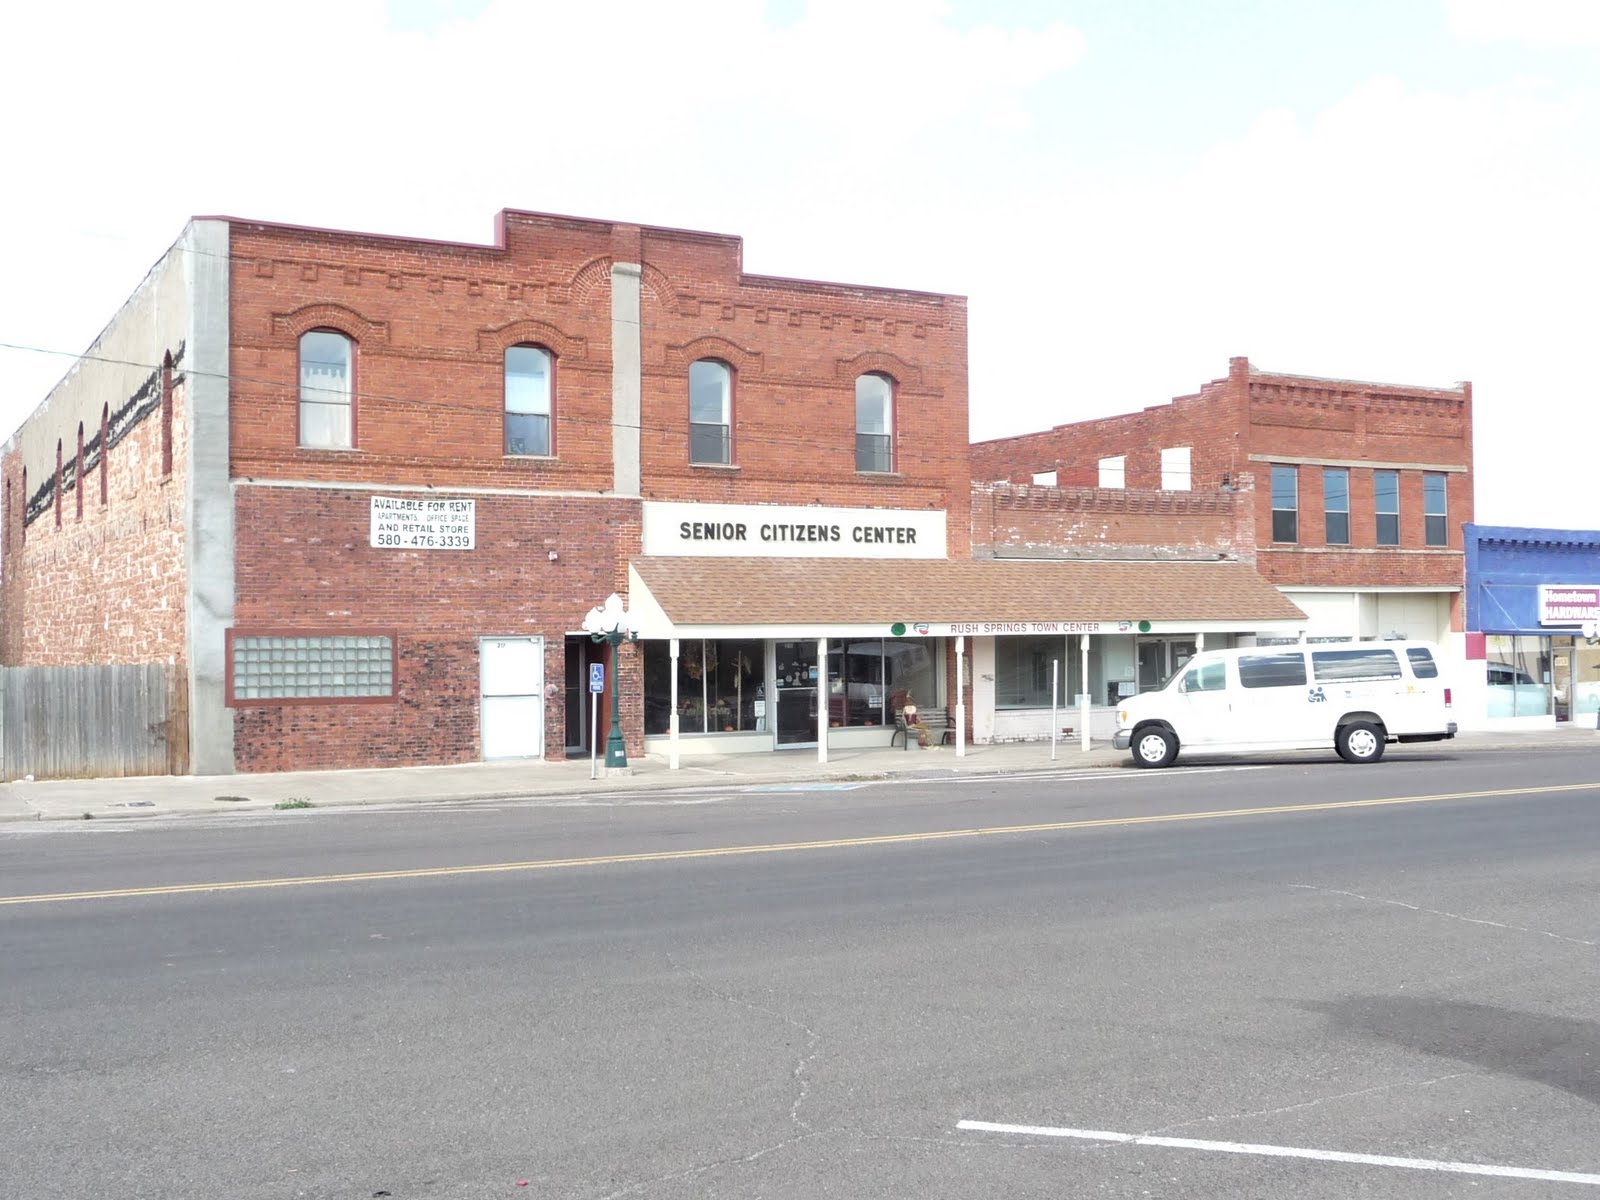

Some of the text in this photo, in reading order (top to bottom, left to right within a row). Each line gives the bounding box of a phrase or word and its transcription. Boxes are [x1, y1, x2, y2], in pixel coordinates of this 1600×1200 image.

[374, 499, 473, 512] AVAILABLE FOR RENT
[426, 514, 448, 523] OFFICE
[451, 514, 470, 523] SPACE
[378, 523, 469, 534] AND RETAIL STORE
[679, 522, 917, 544] SENIOR CITIZENS CENTER
[1545, 590, 1597, 603] Hometown
[950, 622, 1100, 634] RUSH SPRINGS TOWN CENTER
